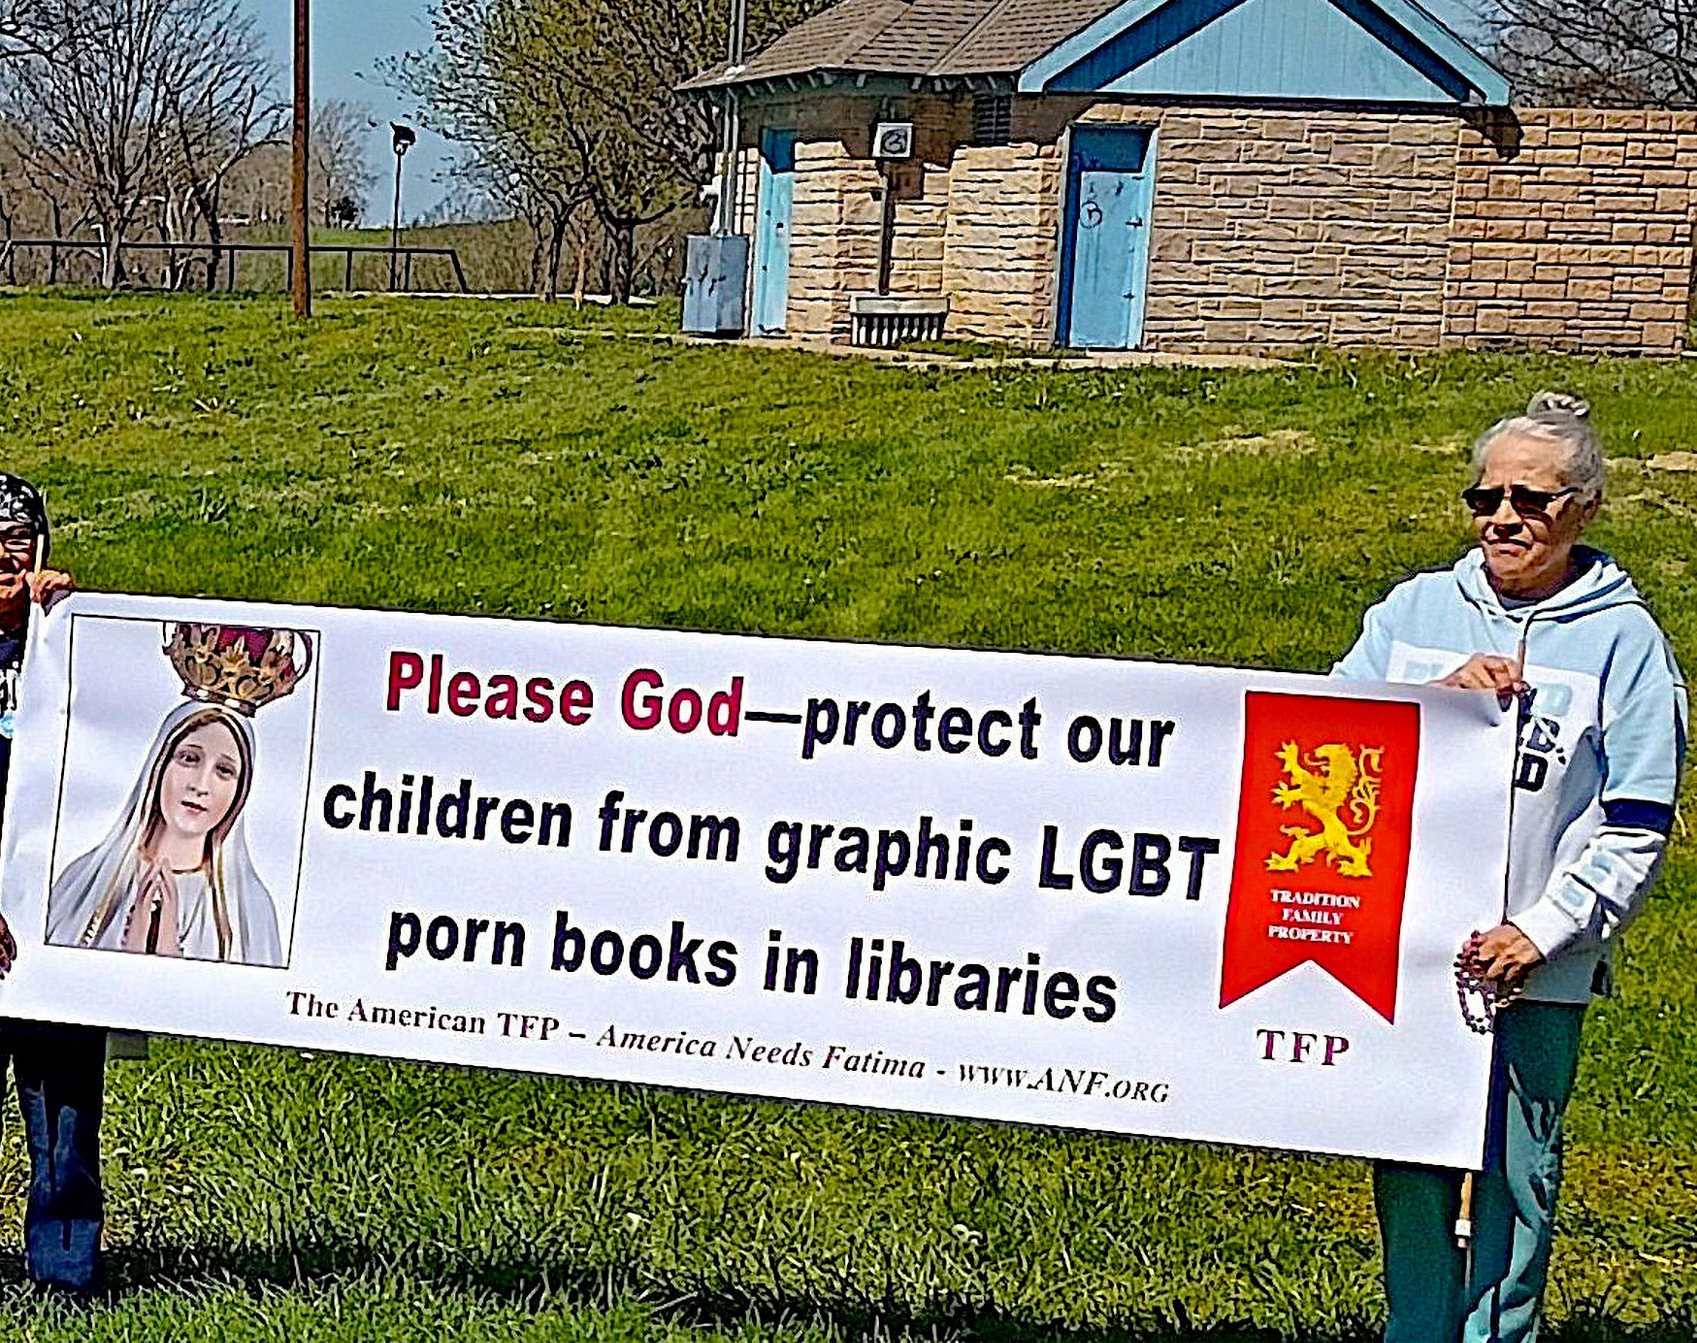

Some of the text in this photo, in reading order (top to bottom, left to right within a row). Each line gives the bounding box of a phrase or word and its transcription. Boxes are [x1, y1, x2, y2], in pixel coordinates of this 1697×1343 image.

[387, 651, 593, 726] Please
[1068, 716, 1175, 767] our
[324, 771, 1220, 901] children from graphic LGBT
[1270, 889, 1360, 909] TRADITION
[1281, 908, 1343, 925] FAMILY
[1268, 924, 1353, 944] PROPERTY
[386, 911, 1117, 1022] porn books in libraries
[287, 992, 338, 1018] The
[348, 999, 485, 1034] American
[498, 1013, 559, 1040] TFP
[597, 1025, 716, 1056] America
[726, 1037, 812, 1066] Needs
[823, 1046, 925, 1078] Fatima
[1257, 1029, 1349, 1065] TFP
